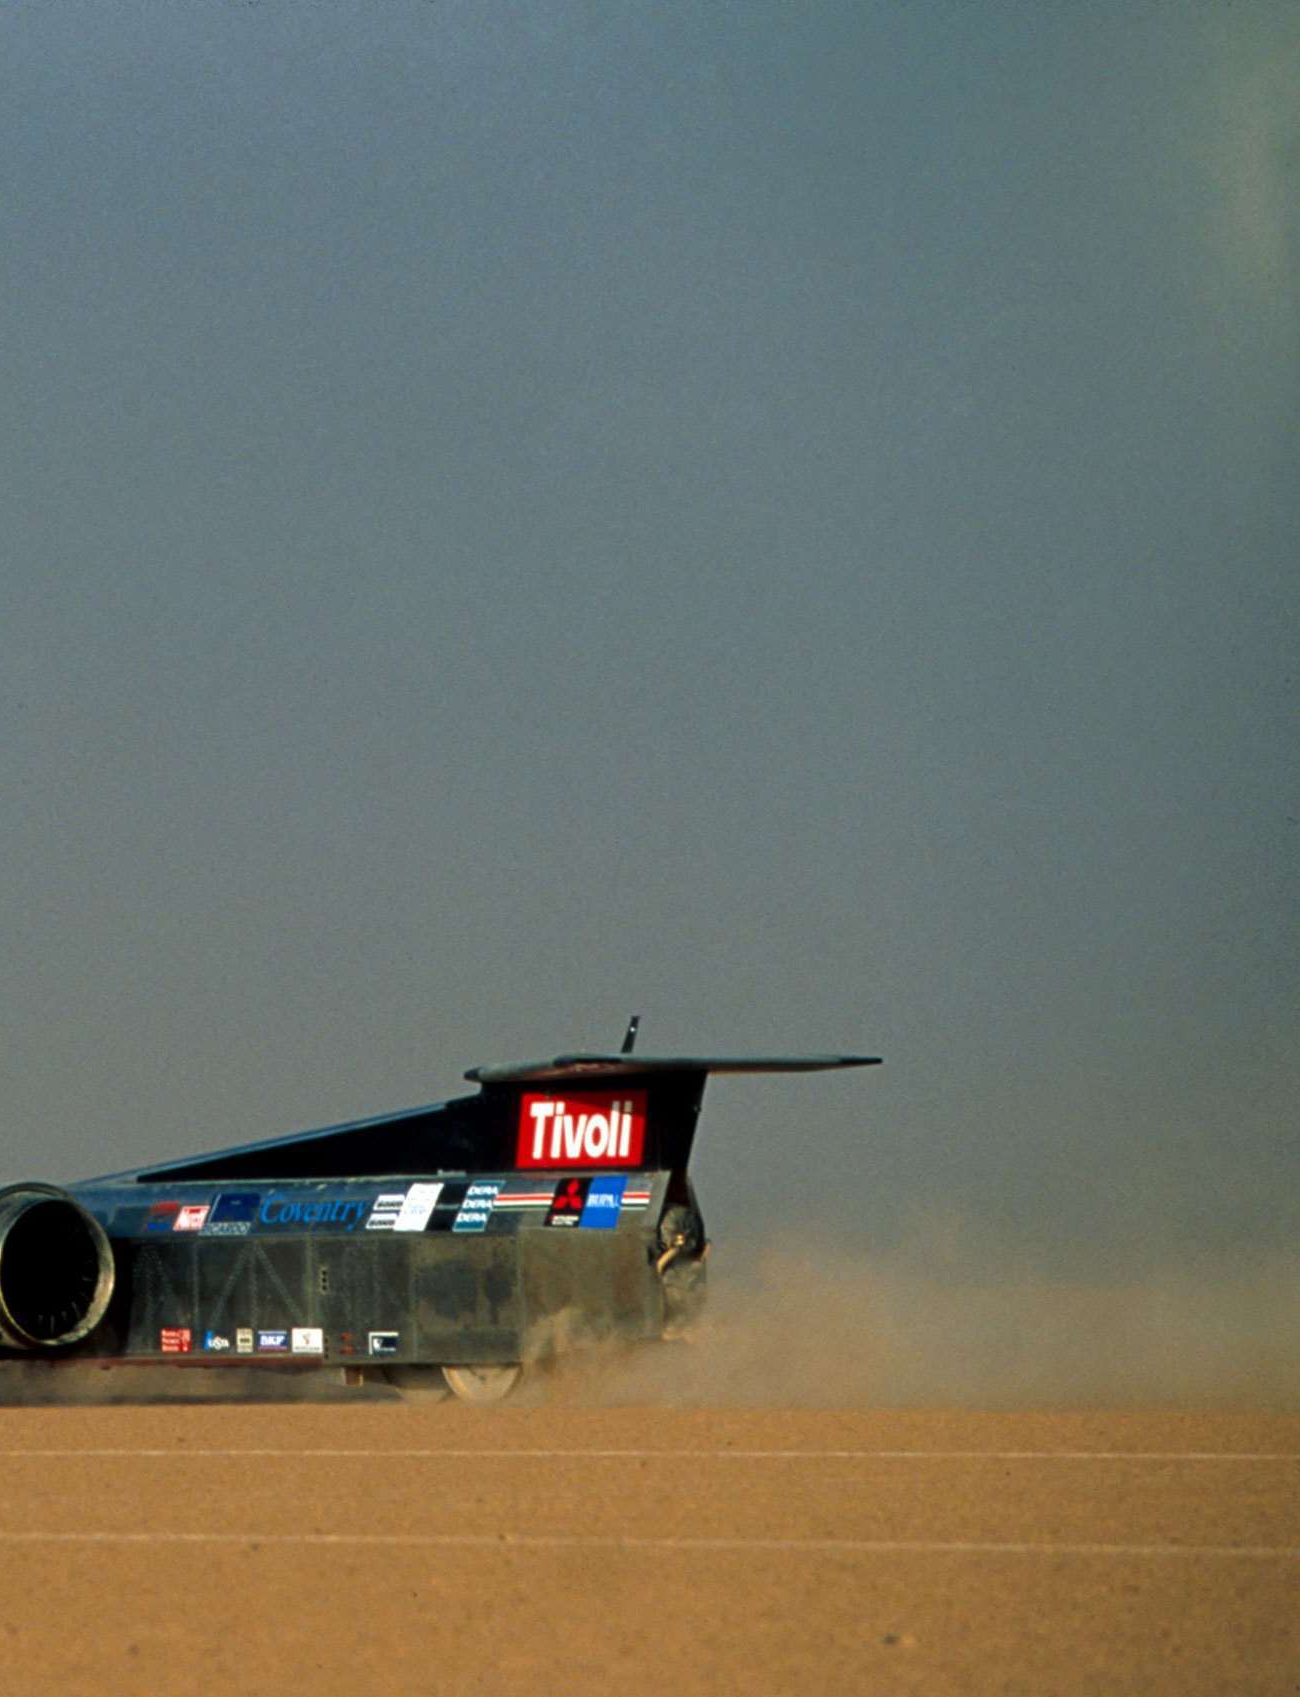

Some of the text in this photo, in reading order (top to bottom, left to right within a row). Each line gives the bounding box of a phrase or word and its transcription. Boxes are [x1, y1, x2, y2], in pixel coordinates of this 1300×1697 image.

[529, 1100, 633, 1160] Tivoli
[467, 1186, 499, 1195] DERA
[462, 1200, 493, 1209] DERA
[260, 1191, 366, 1232] Coventry
[456, 1213, 488, 1222] DERA
